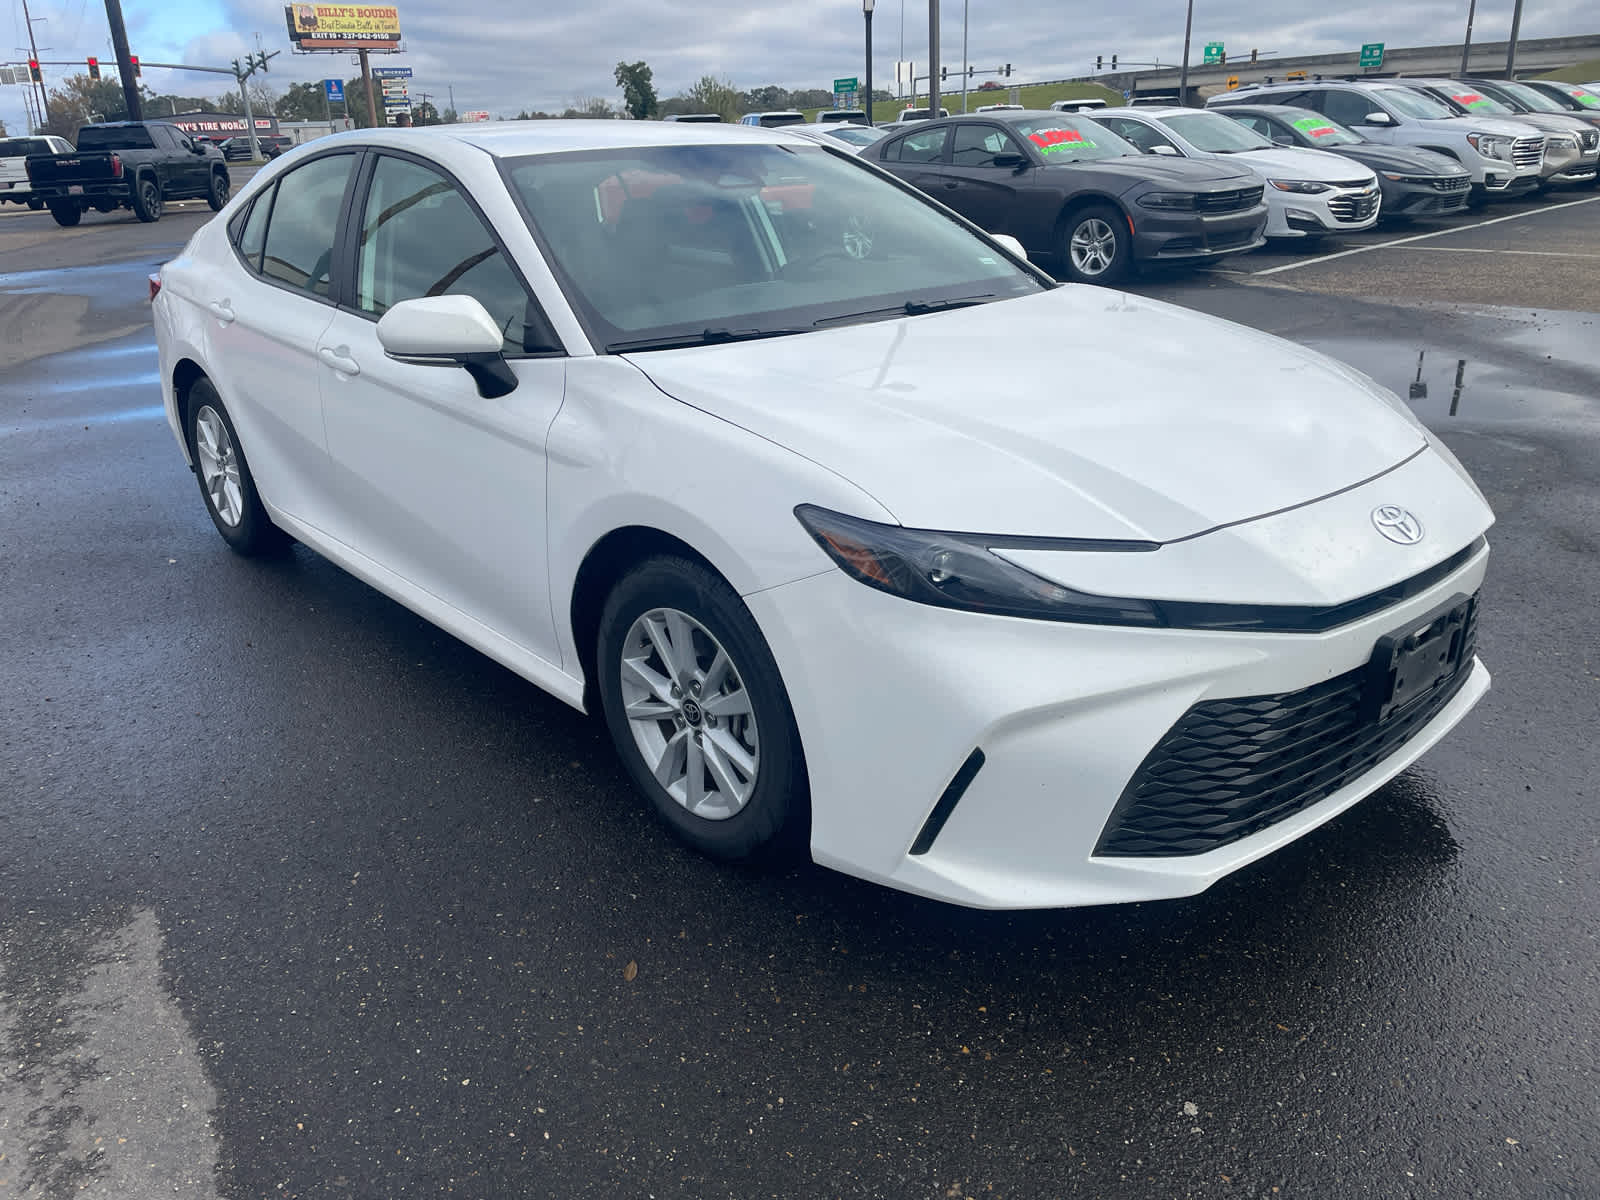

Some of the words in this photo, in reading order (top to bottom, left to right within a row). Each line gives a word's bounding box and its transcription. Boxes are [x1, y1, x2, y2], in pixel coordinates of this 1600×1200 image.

[317, 7, 355, 18] BILLY'S
[356, 7, 397, 18] BOUDIN
[198, 121, 219, 131] TIRE
